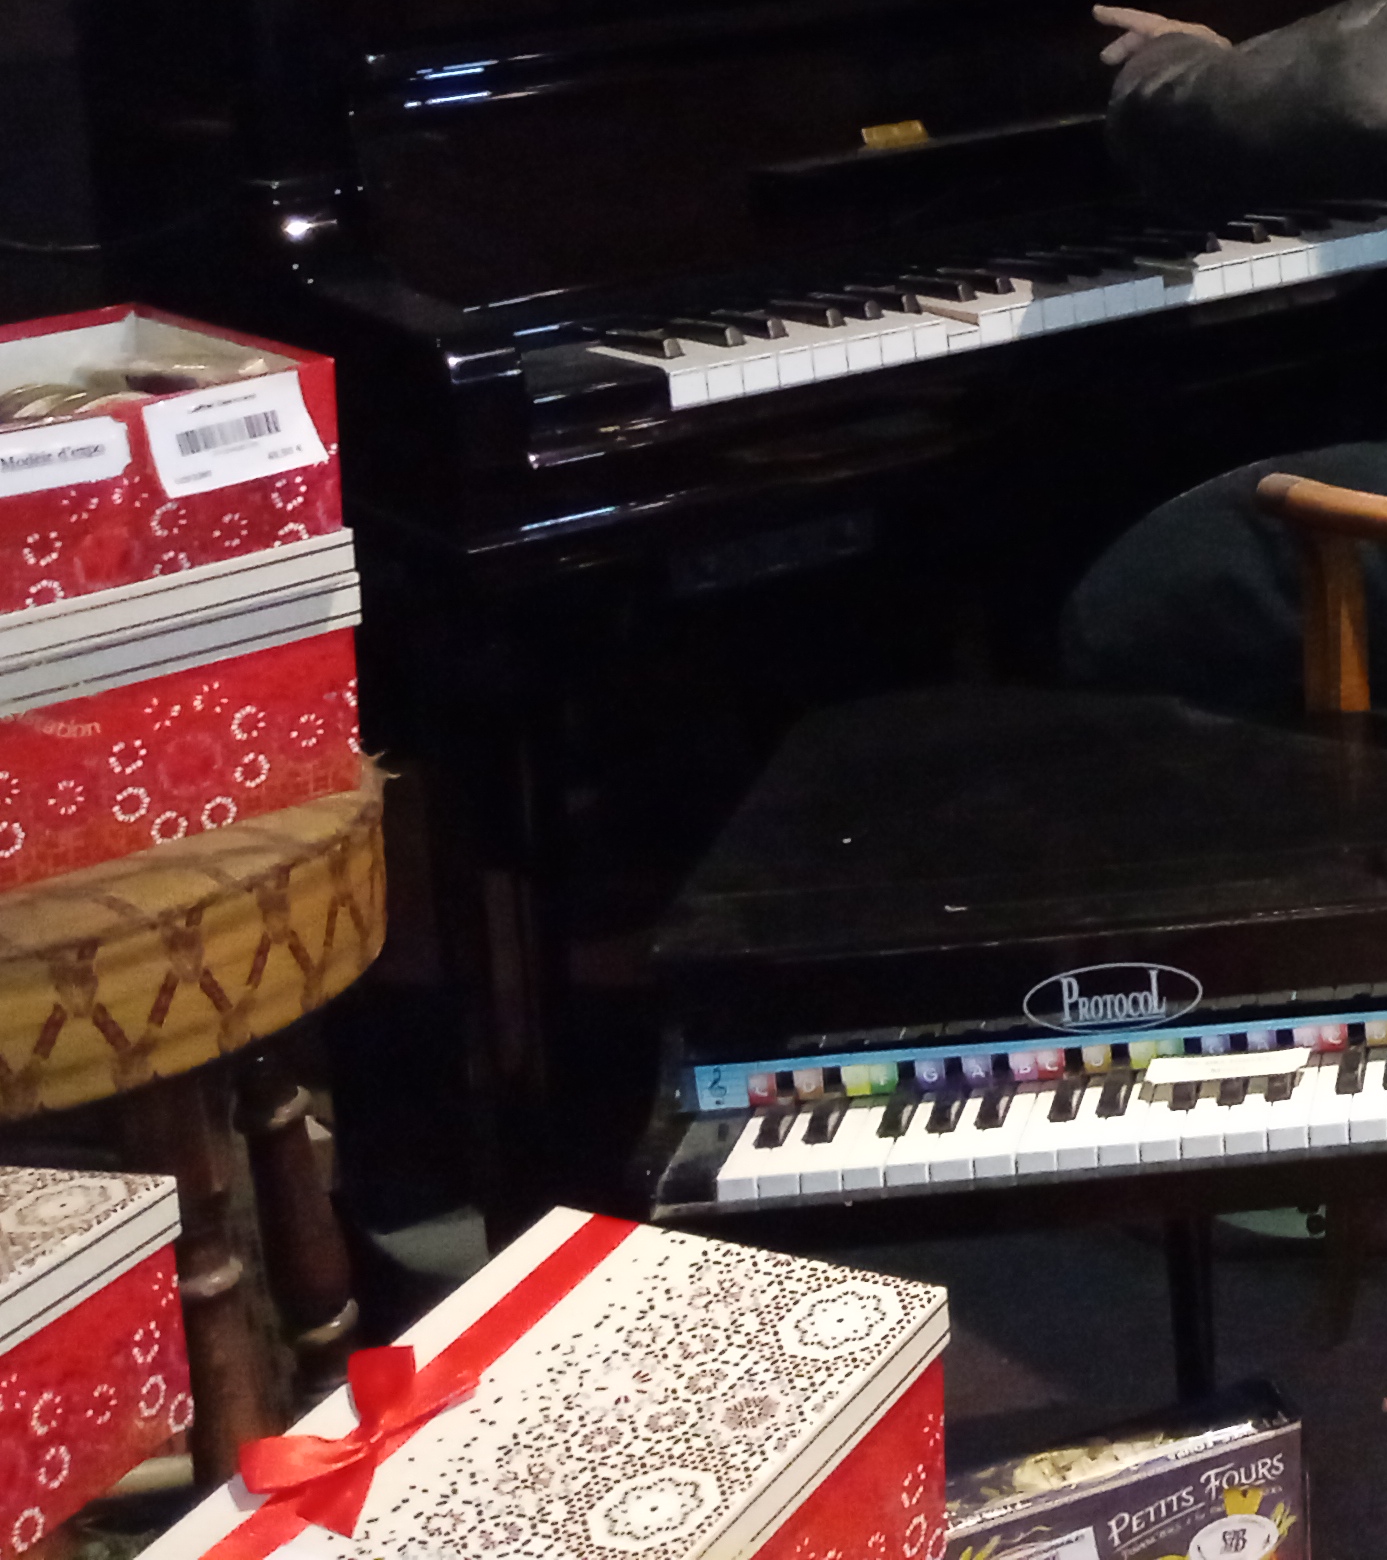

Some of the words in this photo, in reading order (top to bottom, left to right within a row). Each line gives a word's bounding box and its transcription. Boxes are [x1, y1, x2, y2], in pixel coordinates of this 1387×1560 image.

[1060, 968, 1166, 1022] PROTOCOL
[1107, 1486, 1194, 1547] PETITS
[1200, 1452, 1285, 1501] FOURS
